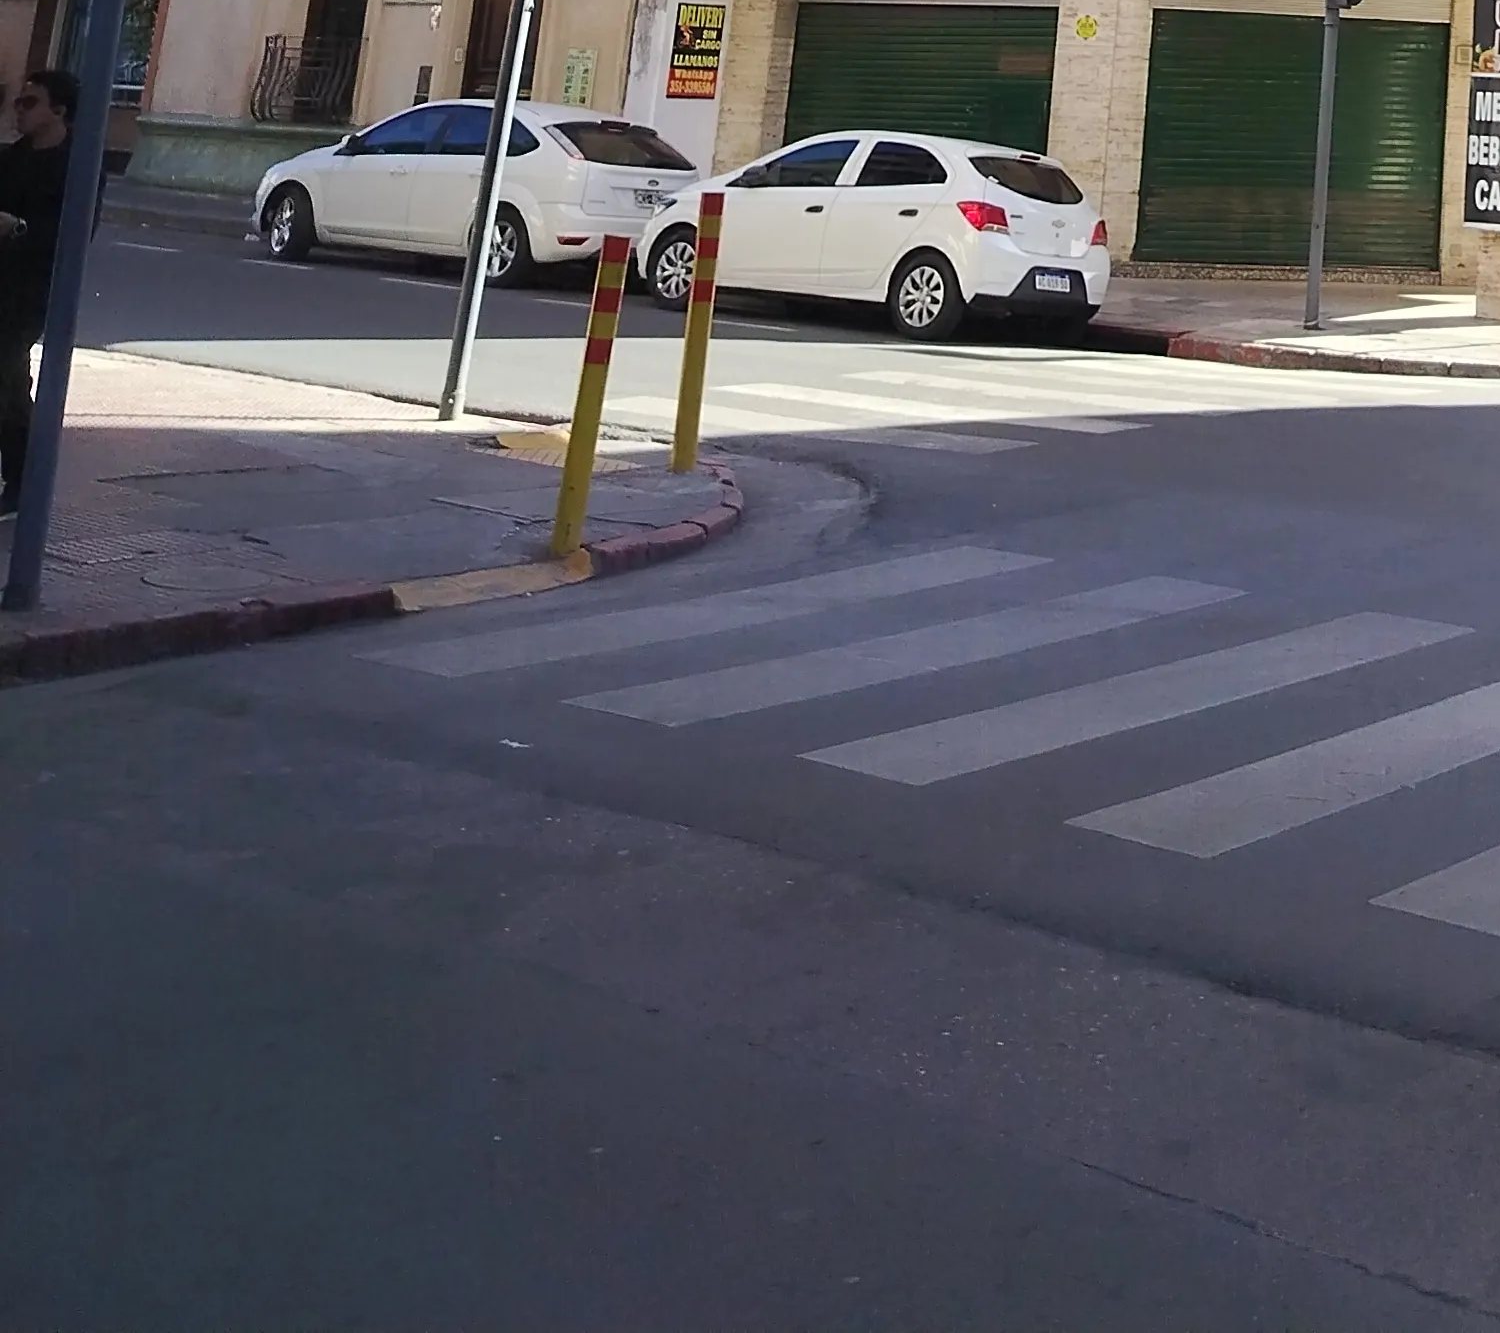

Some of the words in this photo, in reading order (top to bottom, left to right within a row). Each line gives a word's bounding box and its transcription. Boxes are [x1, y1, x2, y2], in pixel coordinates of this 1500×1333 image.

[678, 5, 725, 28] DELIVERY
[702, 29, 717, 39] SIN
[695, 40, 721, 51] CARGO
